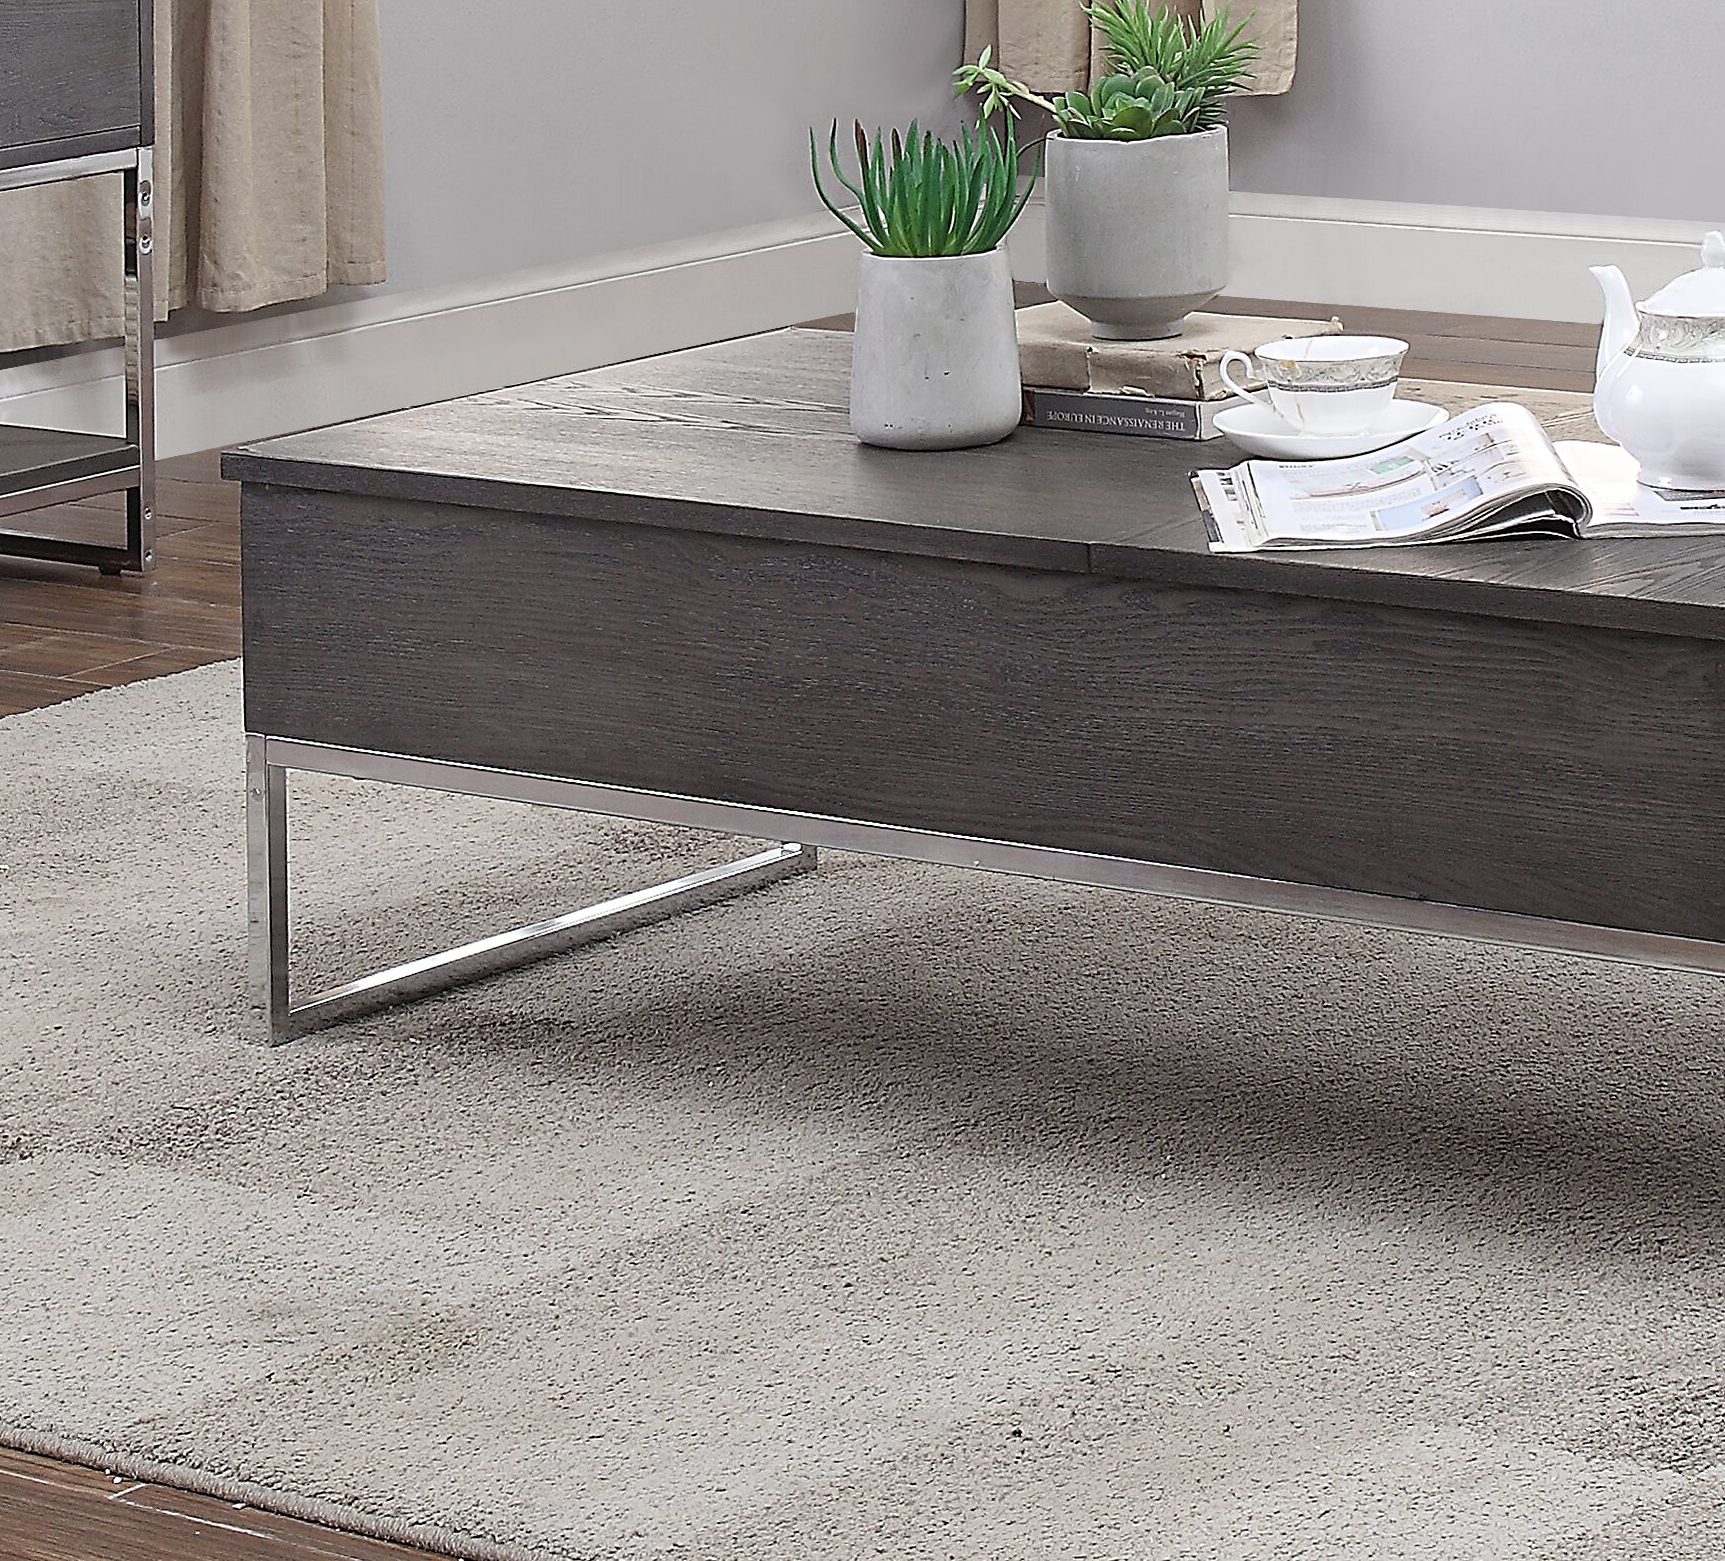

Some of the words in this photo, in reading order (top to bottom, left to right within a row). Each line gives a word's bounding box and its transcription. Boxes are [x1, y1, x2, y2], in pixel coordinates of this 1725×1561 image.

[1046, 410, 1083, 423] EUROPE
[1084, 414, 1096, 424] IN
[1096, 414, 1164, 430] RENAISSANCE
[1165, 420, 1186, 432] THE
